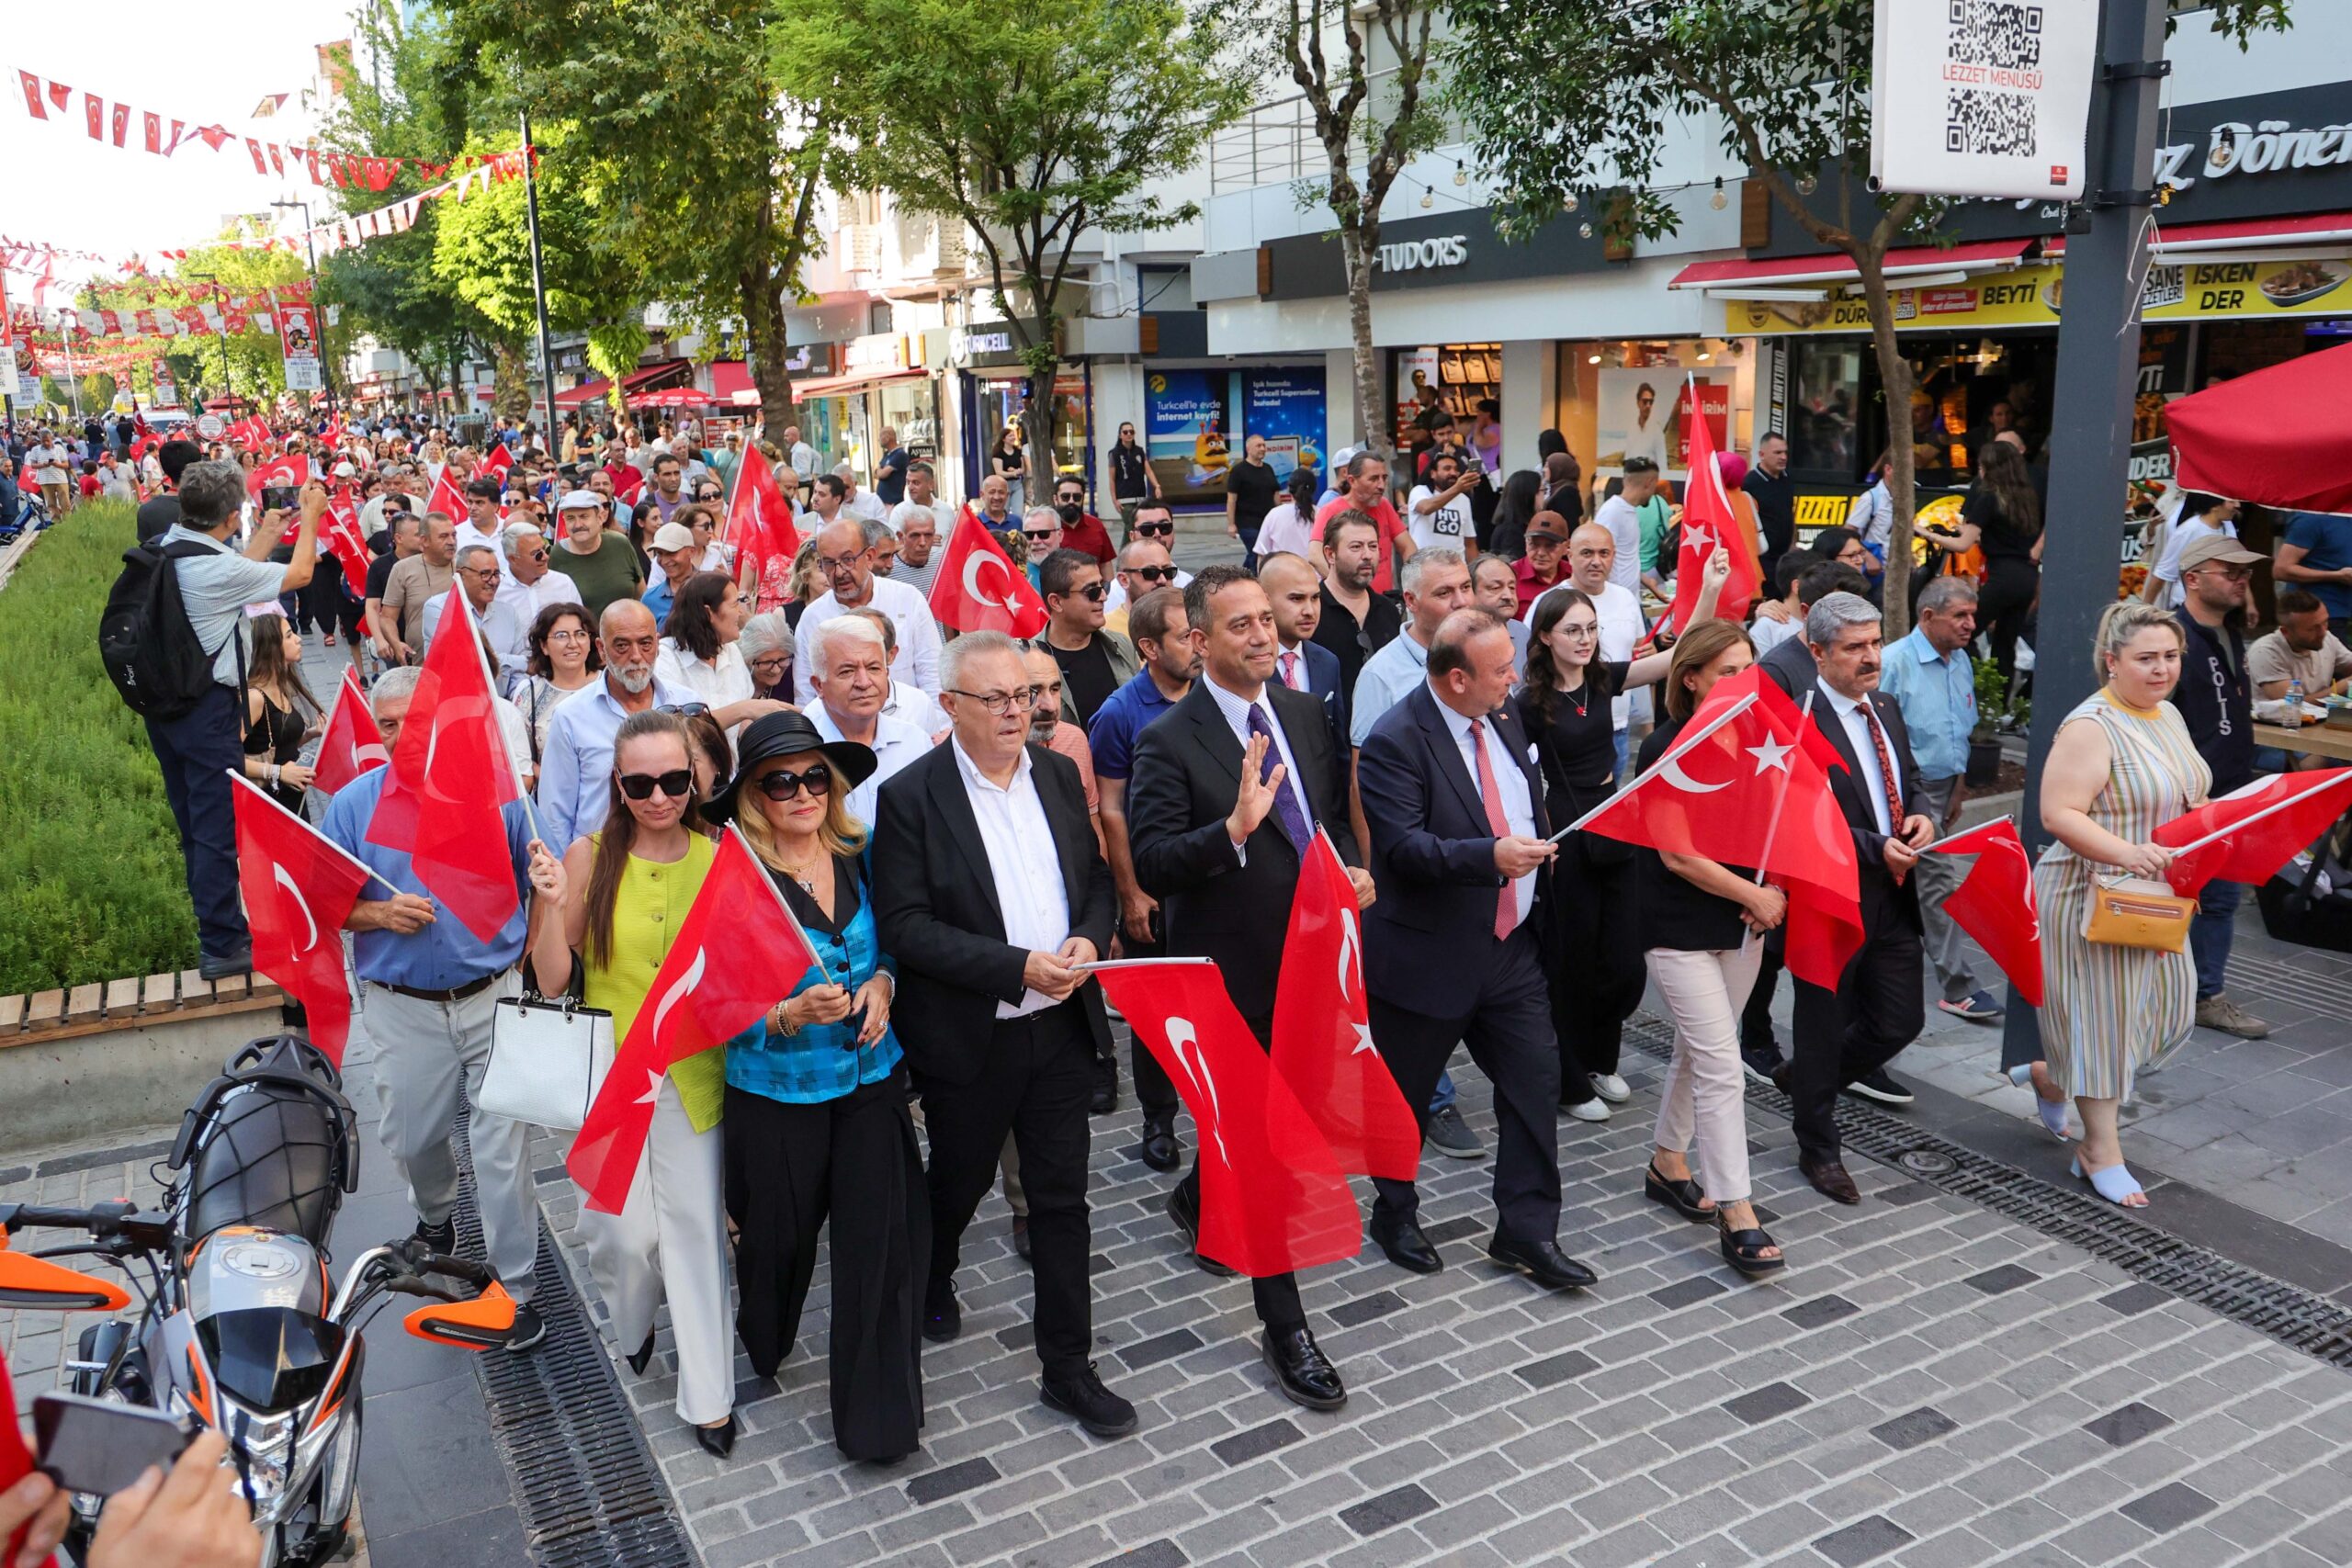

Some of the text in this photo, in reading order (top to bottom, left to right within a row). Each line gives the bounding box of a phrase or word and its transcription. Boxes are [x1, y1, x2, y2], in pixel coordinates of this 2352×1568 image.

[1943, 63, 2043, 90] LEZZET MENÜSÜ
[1379, 234, 1467, 273] TUDORS
[1983, 277, 2038, 306] BEYTİ
[2199, 289, 2245, 310] DER
[1157, 412, 1193, 422] internet
[1436, 521, 1459, 534] GO
